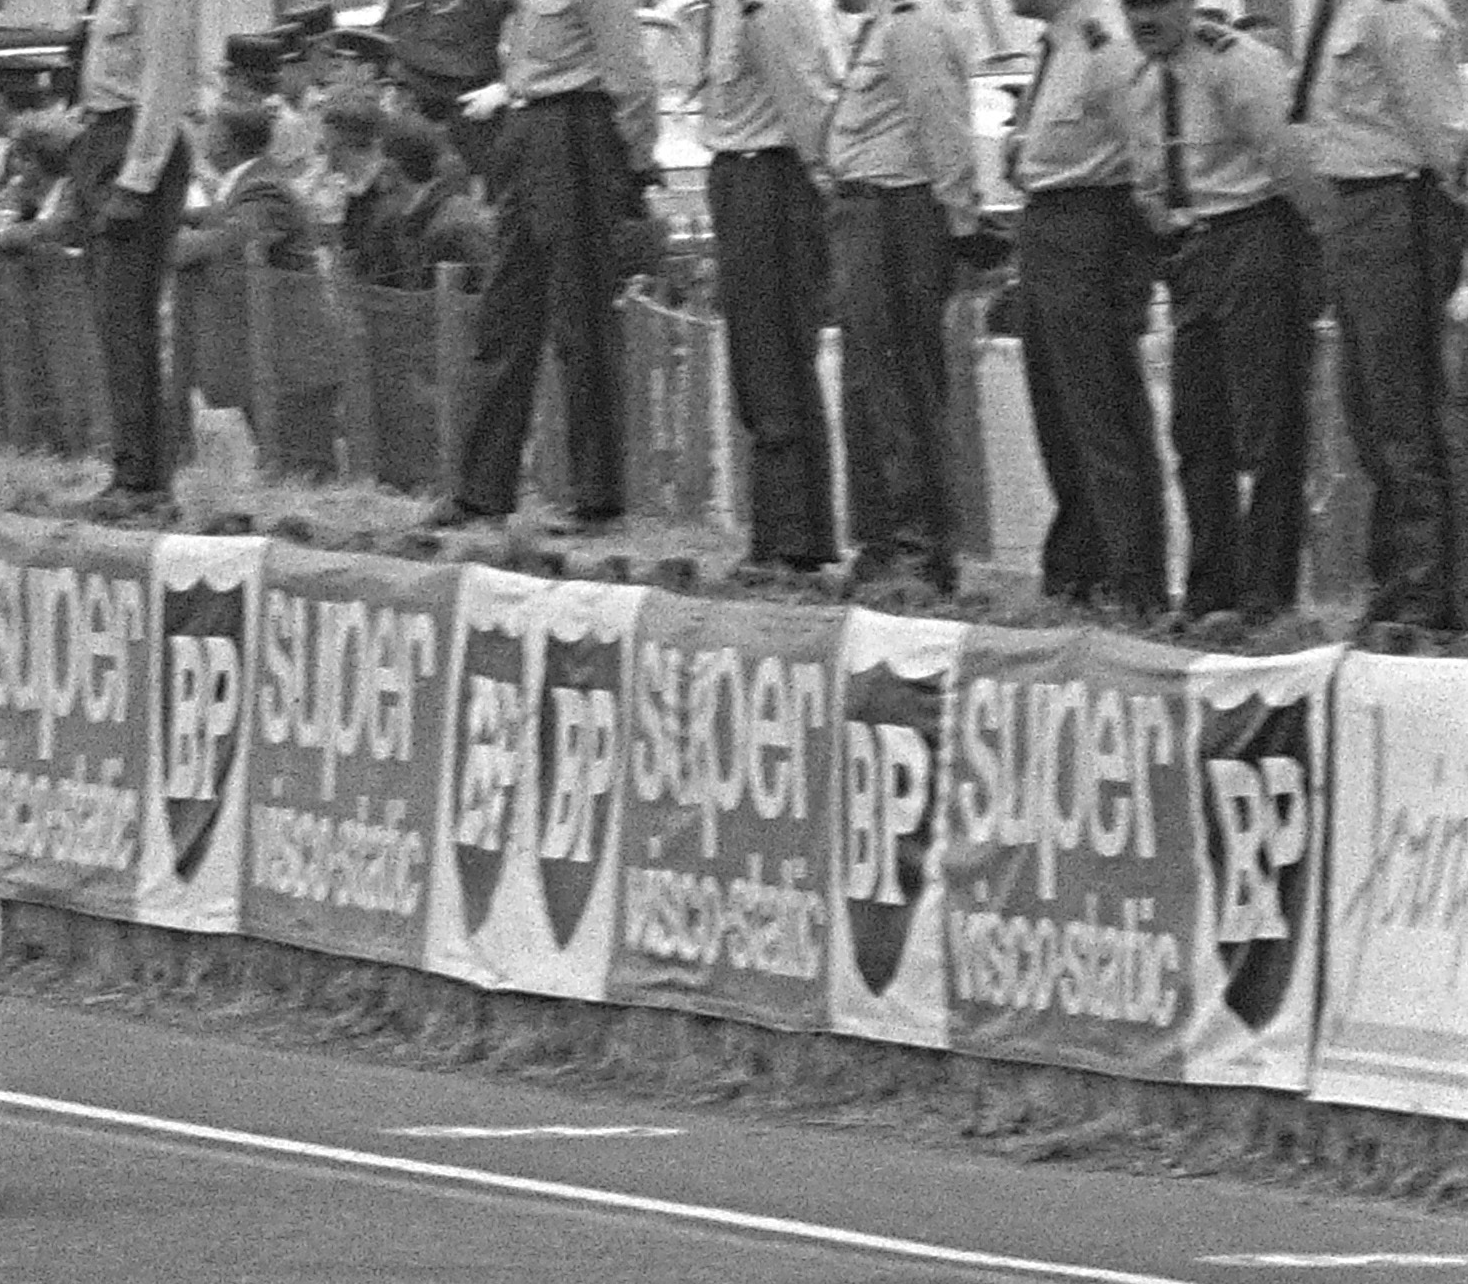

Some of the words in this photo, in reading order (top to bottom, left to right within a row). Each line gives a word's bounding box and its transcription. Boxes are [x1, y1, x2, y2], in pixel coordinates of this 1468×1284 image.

[164, 635, 239, 800] BP
[260, 589, 438, 801] super
[539, 687, 618, 861] BP
[633, 640, 825, 860] super
[958, 677, 1175, 901] super
[842, 719, 930, 907] BP
[1207, 755, 1306, 945] BP
